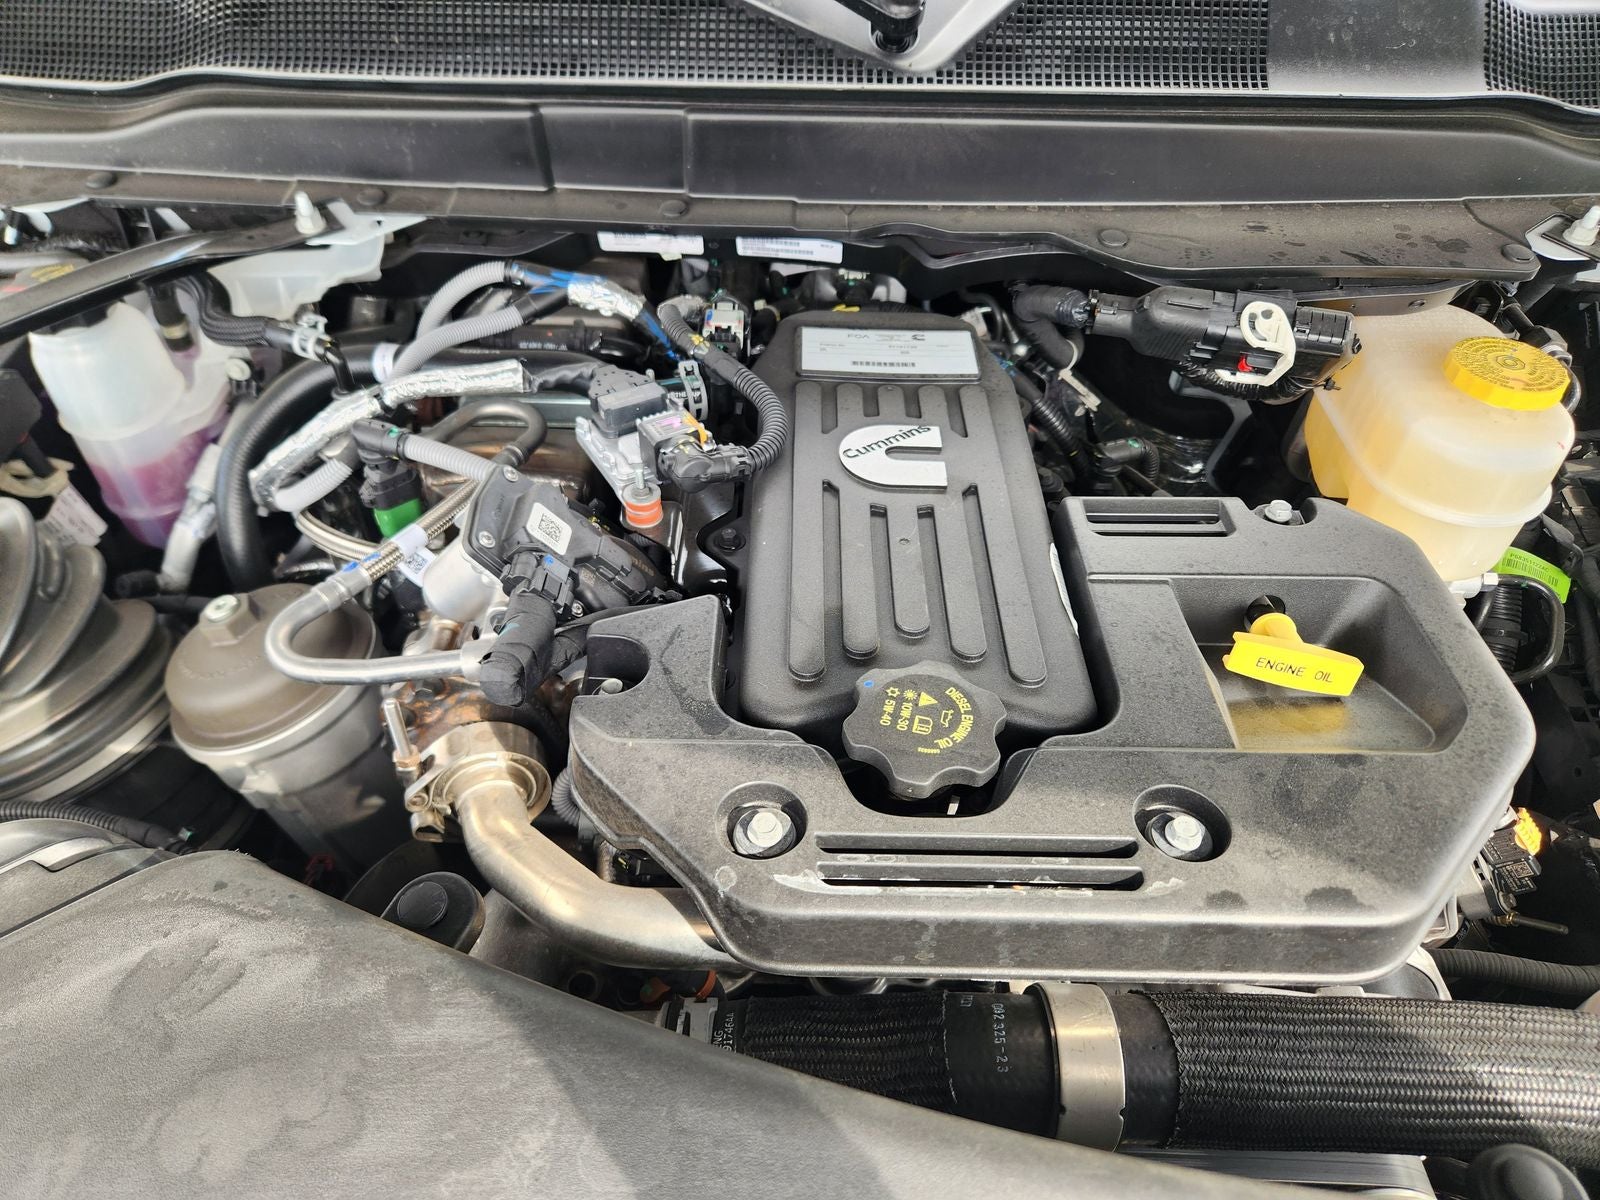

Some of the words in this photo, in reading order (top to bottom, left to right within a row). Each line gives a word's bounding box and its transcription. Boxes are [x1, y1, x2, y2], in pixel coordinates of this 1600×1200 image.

[842, 425, 931, 459] Cummins
[1255, 657, 1307, 678] ENGINE
[1314, 670, 1333, 683] OIL
[880, 699, 895, 726] 5W-40
[945, 687, 972, 714] DIESEL
[897, 702, 913, 731] 10W-30
[949, 714, 973, 743] ENGINE
[934, 737, 953, 749] OIL
